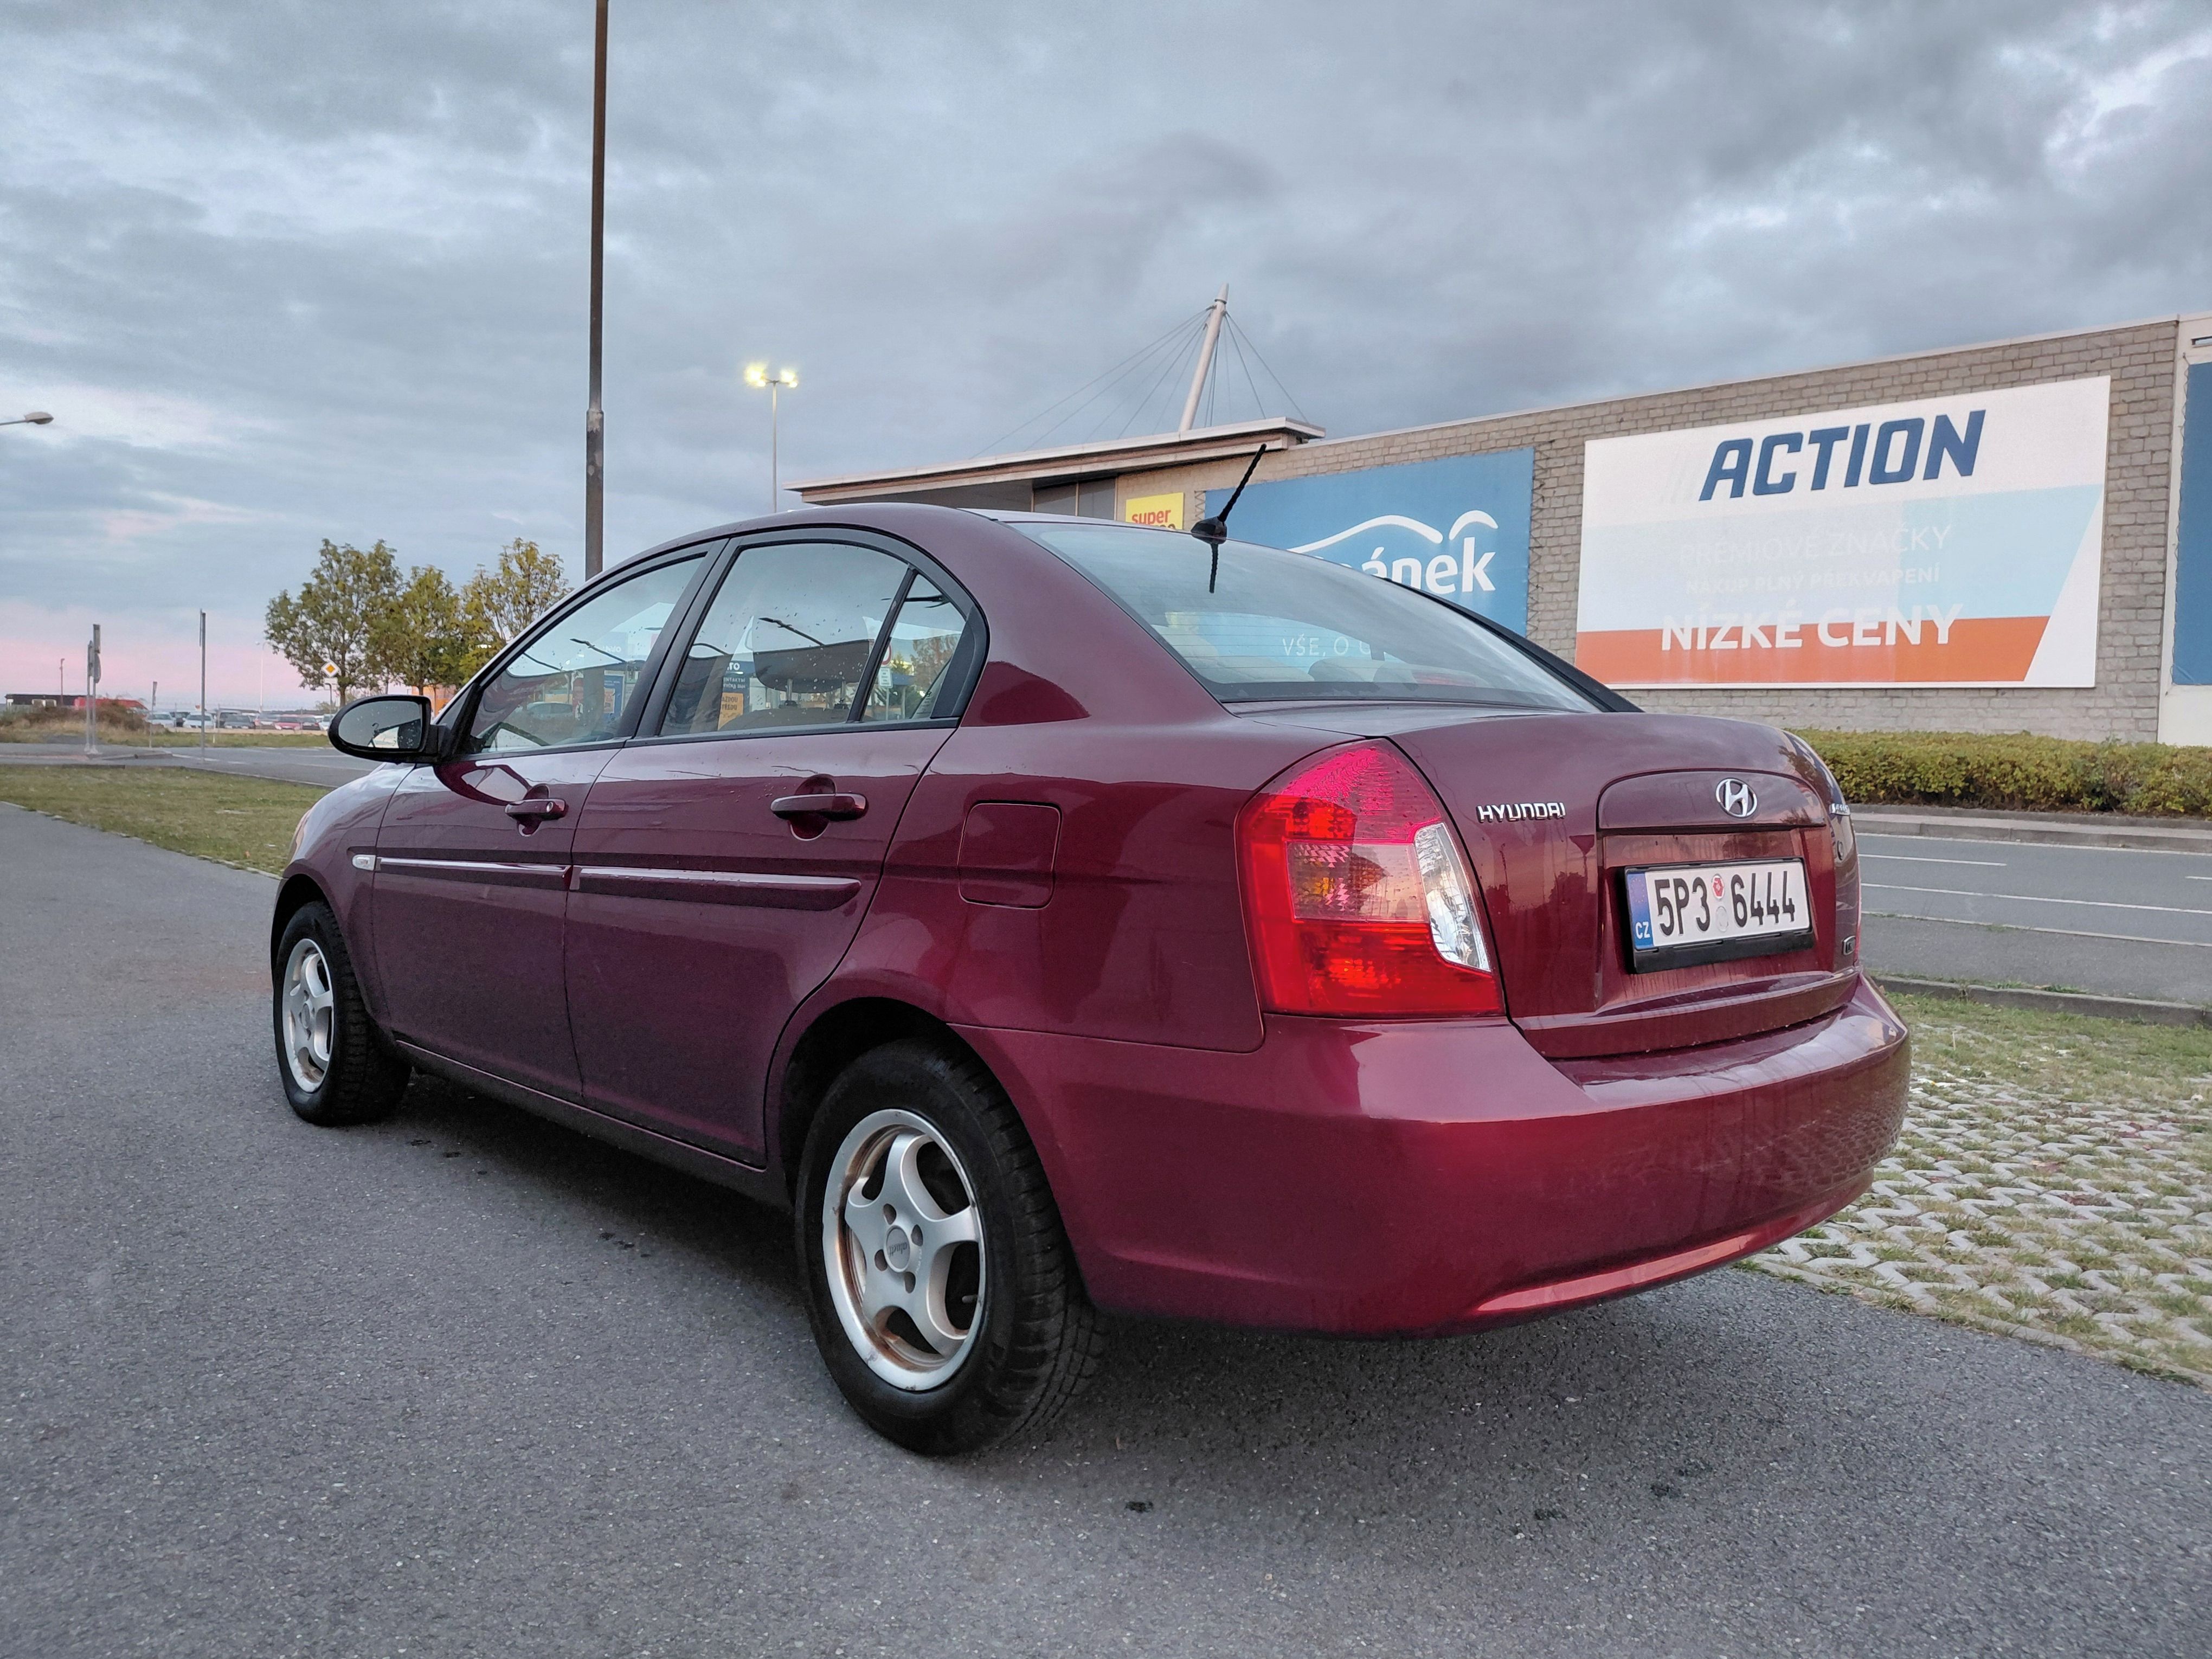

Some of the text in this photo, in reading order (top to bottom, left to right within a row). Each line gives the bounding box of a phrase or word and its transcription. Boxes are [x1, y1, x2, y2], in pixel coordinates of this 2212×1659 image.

[1699, 410, 1986, 501] ACTION
[1131, 510, 1171, 525] super
[1828, 523, 1952, 555] ZNAČKY
[1315, 537, 1496, 595] ánek
[1810, 562, 1940, 590] PŘEKVAPENÍ
[1662, 600, 1963, 651] NÍZKÉ CENY
[1282, 633, 1326, 657] VŠE,
[1334, 636, 1349, 656] O
[1476, 802, 1566, 823] HYUNDAI
[1654, 871, 1795, 936] 5P3 6444
[1635, 922, 1650, 940] CZ
